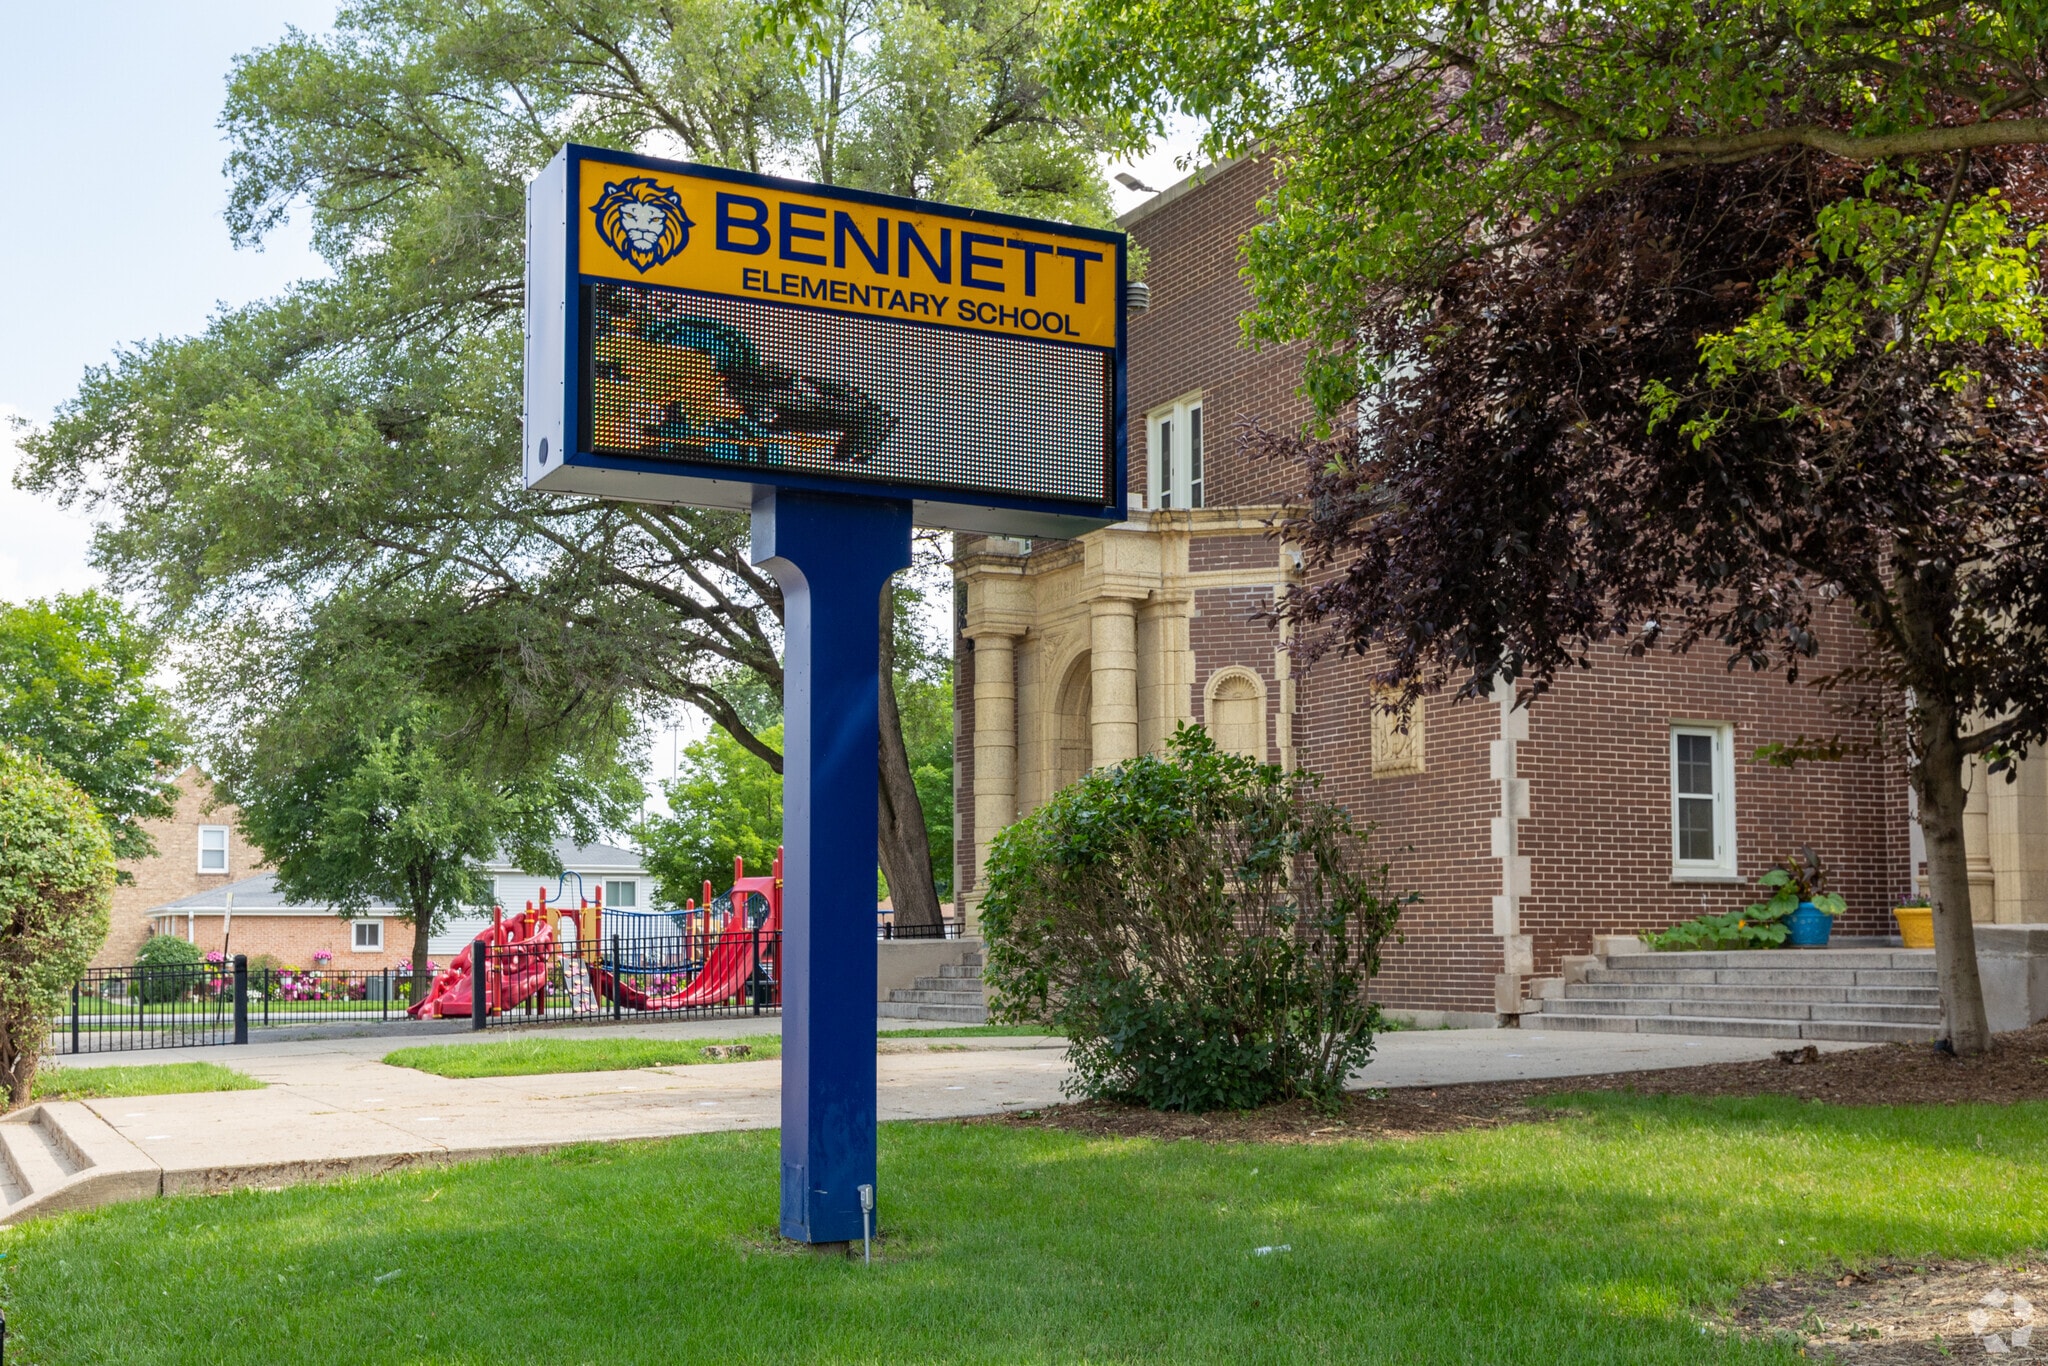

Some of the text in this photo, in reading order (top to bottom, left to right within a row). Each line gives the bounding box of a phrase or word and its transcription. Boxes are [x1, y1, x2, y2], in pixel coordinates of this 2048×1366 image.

[716, 191, 1103, 304] BENNETT
[742, 268, 1080, 337] ELEMENTARY SCHOOL
